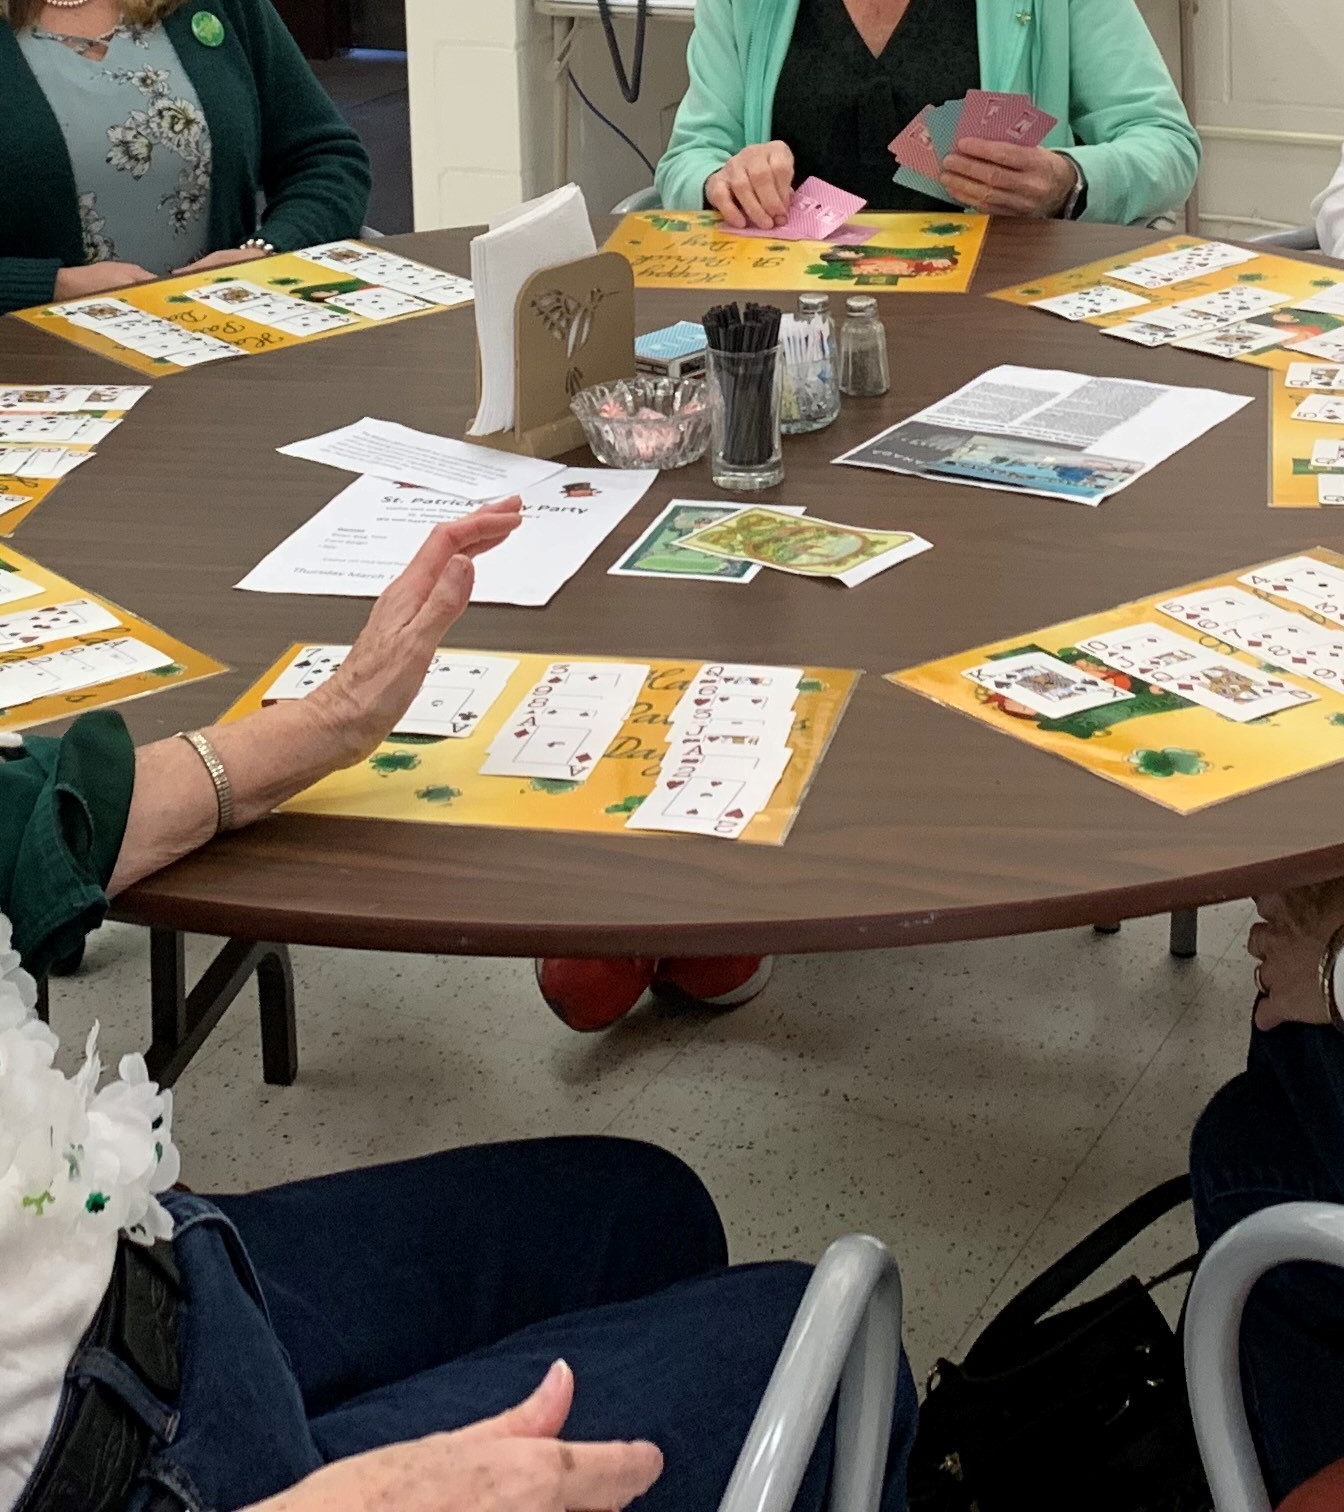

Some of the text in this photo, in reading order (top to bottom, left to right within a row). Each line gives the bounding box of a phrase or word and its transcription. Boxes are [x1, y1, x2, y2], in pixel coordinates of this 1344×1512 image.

[636, 264, 727, 284] Happy
[381, 495, 404, 504] St.
[537, 505, 589, 515] Party
[294, 567, 344, 577] Thursday
[1251, 574, 1272, 586] 4
[1163, 602, 1186, 614] 5
[1268, 645, 1291, 657] 8
[706, 666, 725, 677] Q
[970, 669, 995, 682] K
[1152, 671, 1175, 683] Q
[516, 716, 537, 727] A
[683, 745, 703, 756] A
